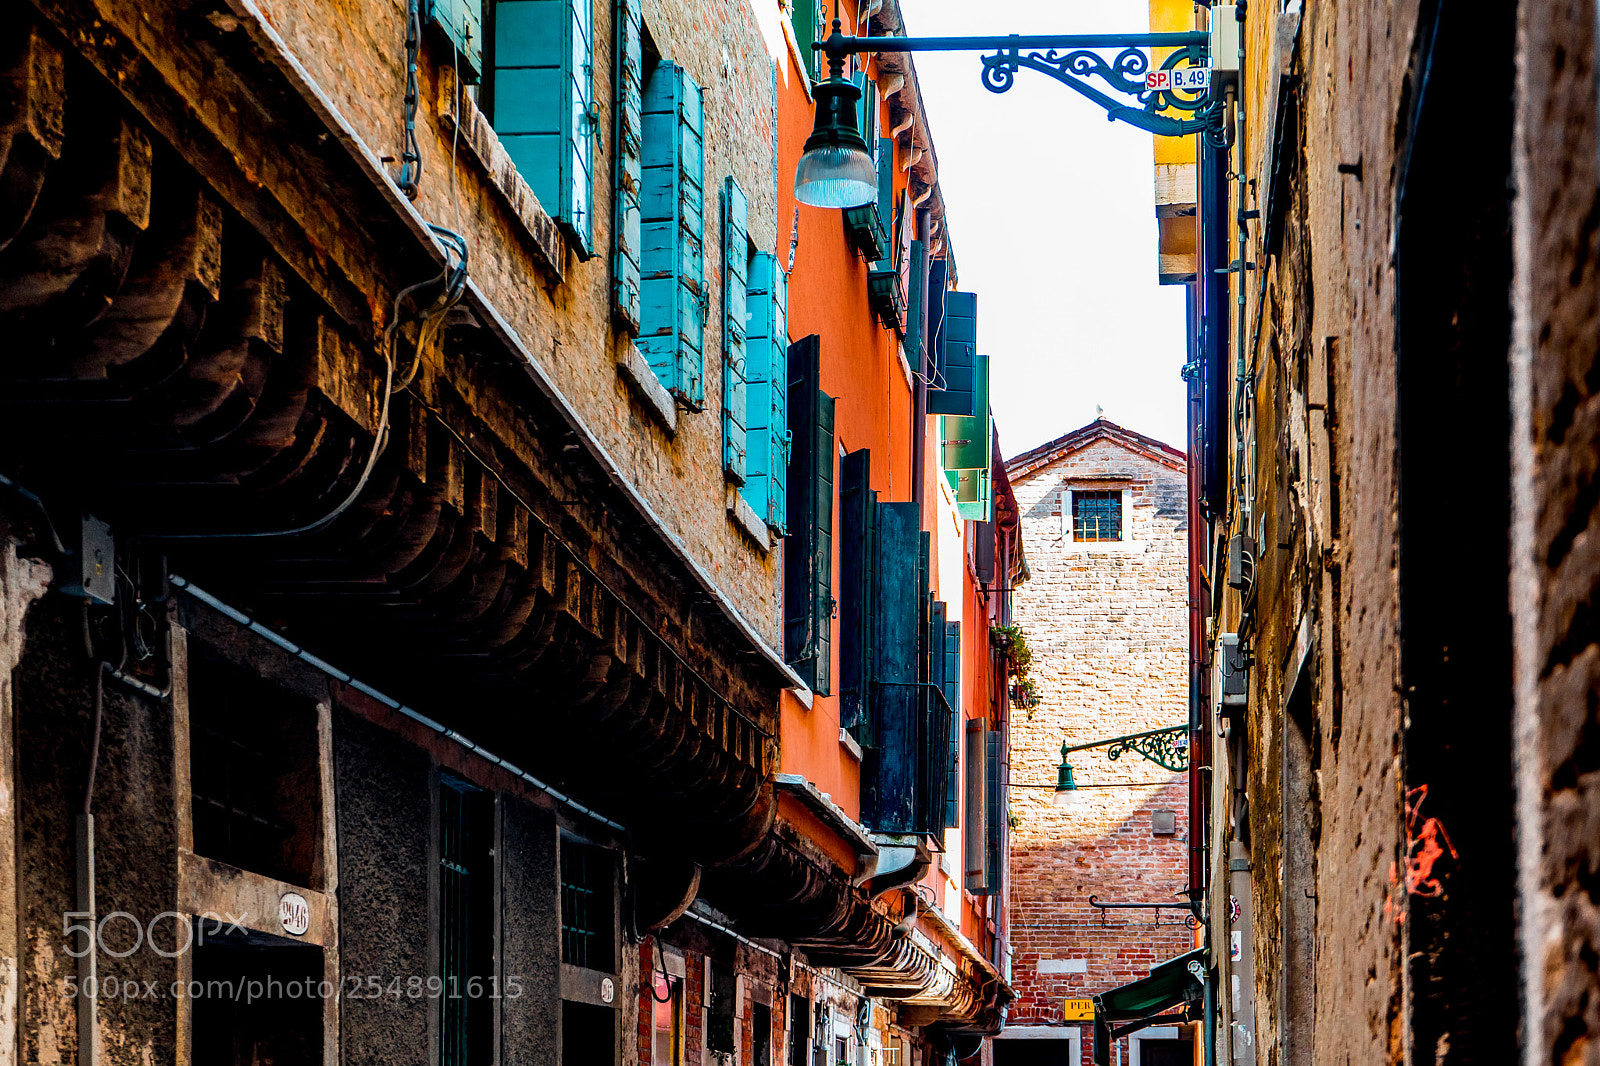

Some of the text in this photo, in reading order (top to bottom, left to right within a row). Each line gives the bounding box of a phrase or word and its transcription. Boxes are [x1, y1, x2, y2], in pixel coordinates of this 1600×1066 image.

[1147, 72, 1169, 88] SP.
[1188, 70, 1205, 85] 49
[282, 901, 306, 928] 2946
[1071, 1001, 1090, 1010] PER
